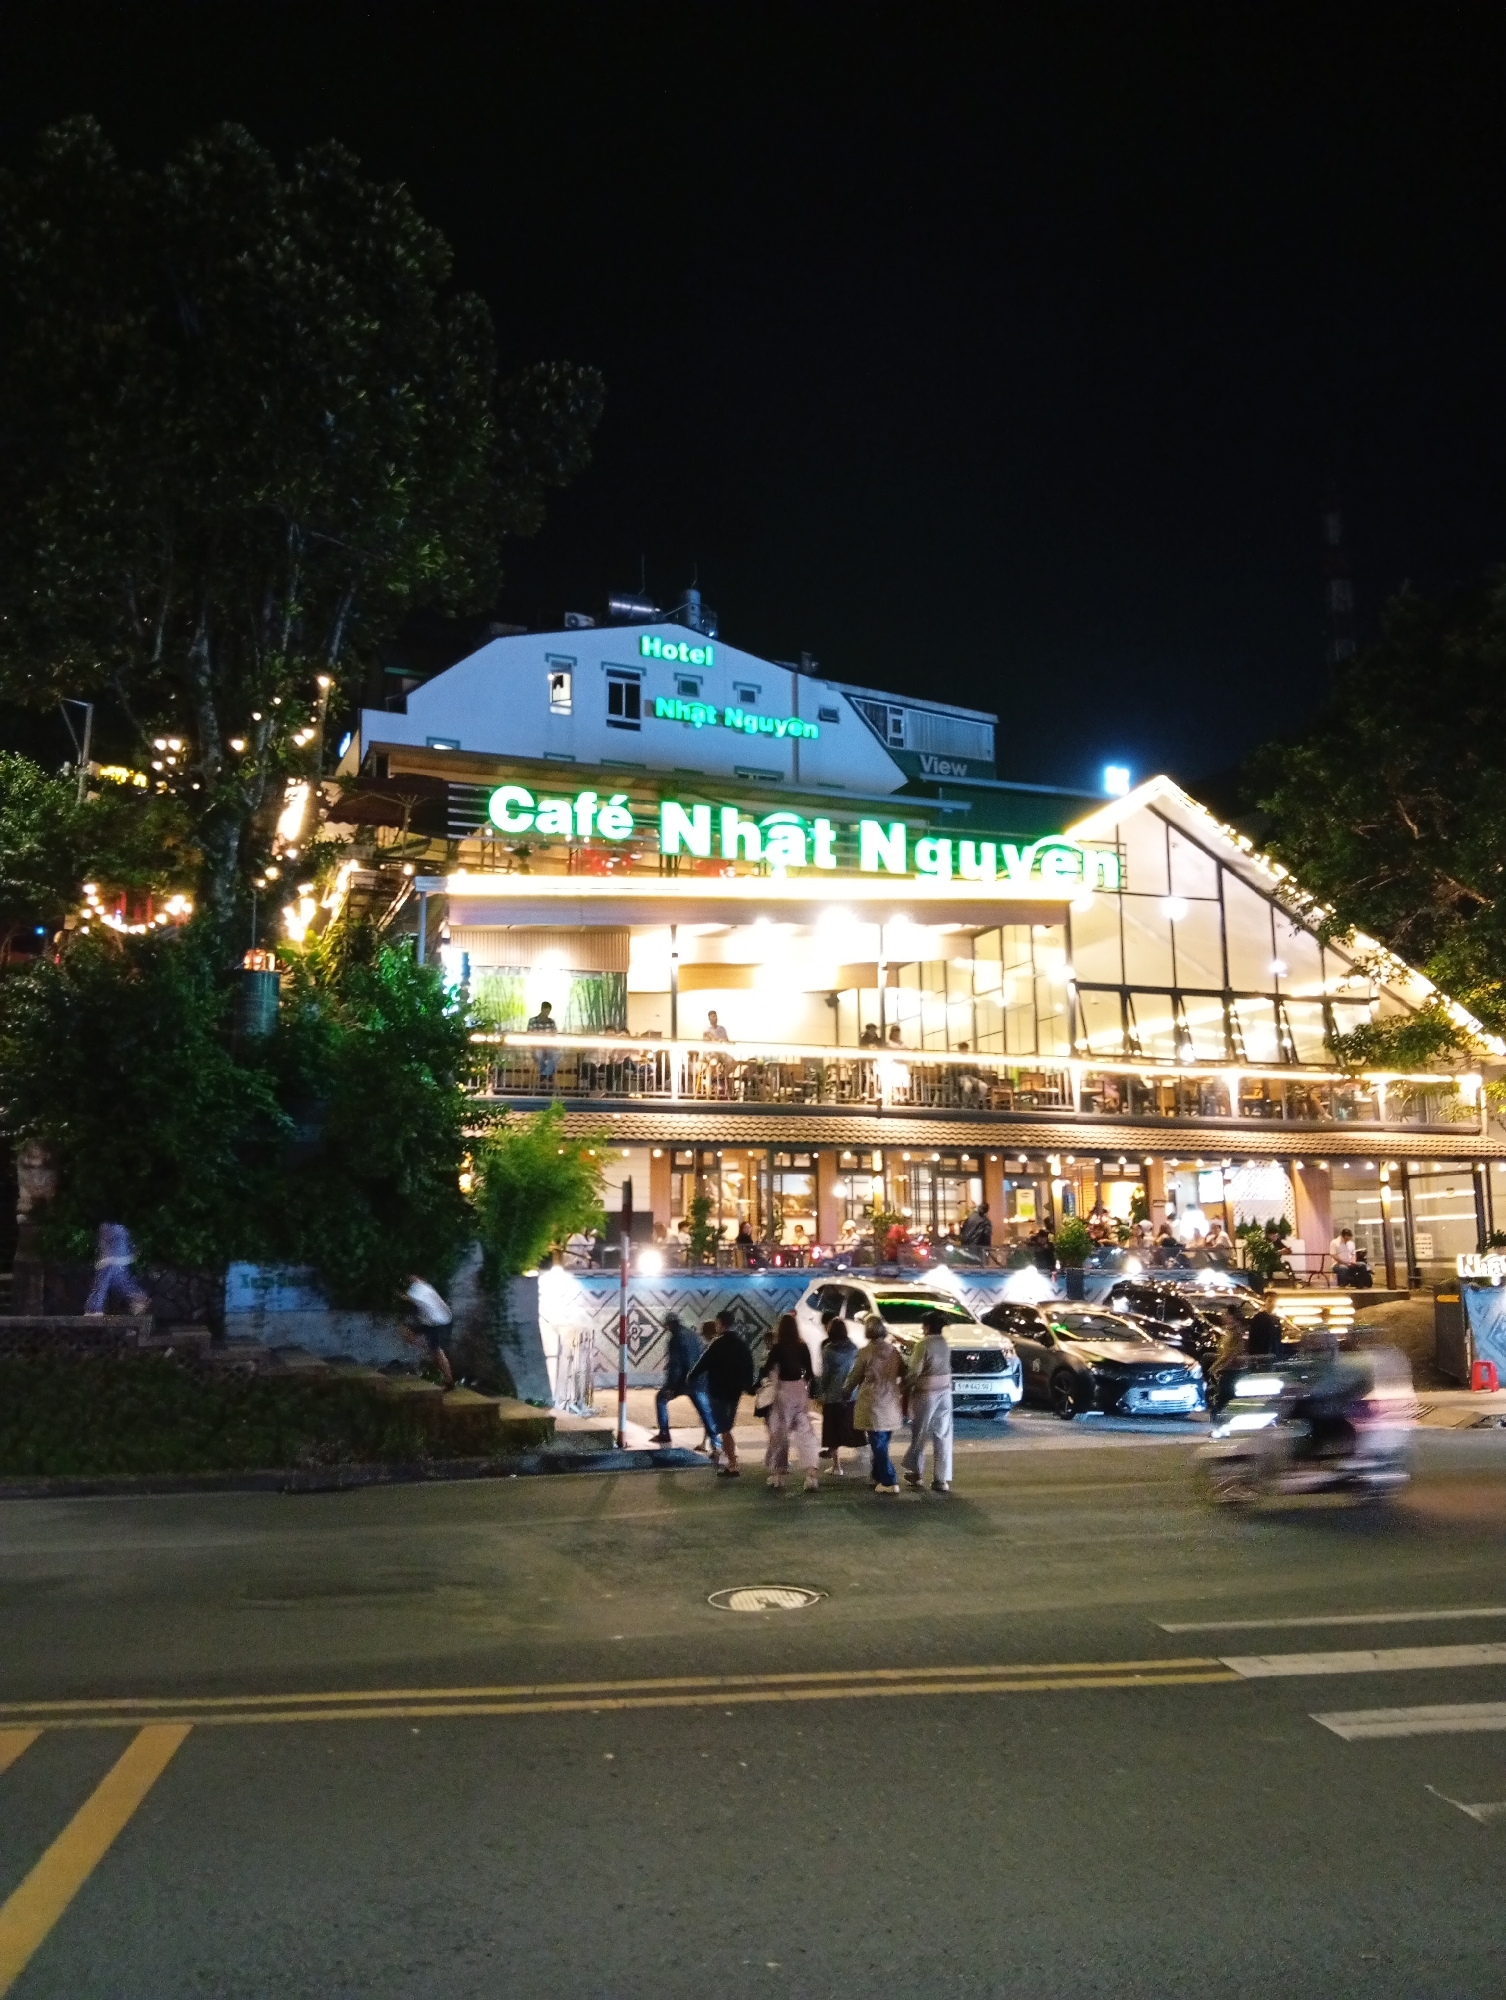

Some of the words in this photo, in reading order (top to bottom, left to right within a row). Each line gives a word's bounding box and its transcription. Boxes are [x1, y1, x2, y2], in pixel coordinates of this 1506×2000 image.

[640, 634, 715, 667] Hotel
[655, 697, 717, 728] Nhật
[724, 707, 819, 740] Nguyên
[919, 753, 969, 778] View
[488, 785, 635, 841] Café
[659, 799, 838, 879] Nhật
[858, 818, 1121, 890] Nguyên
